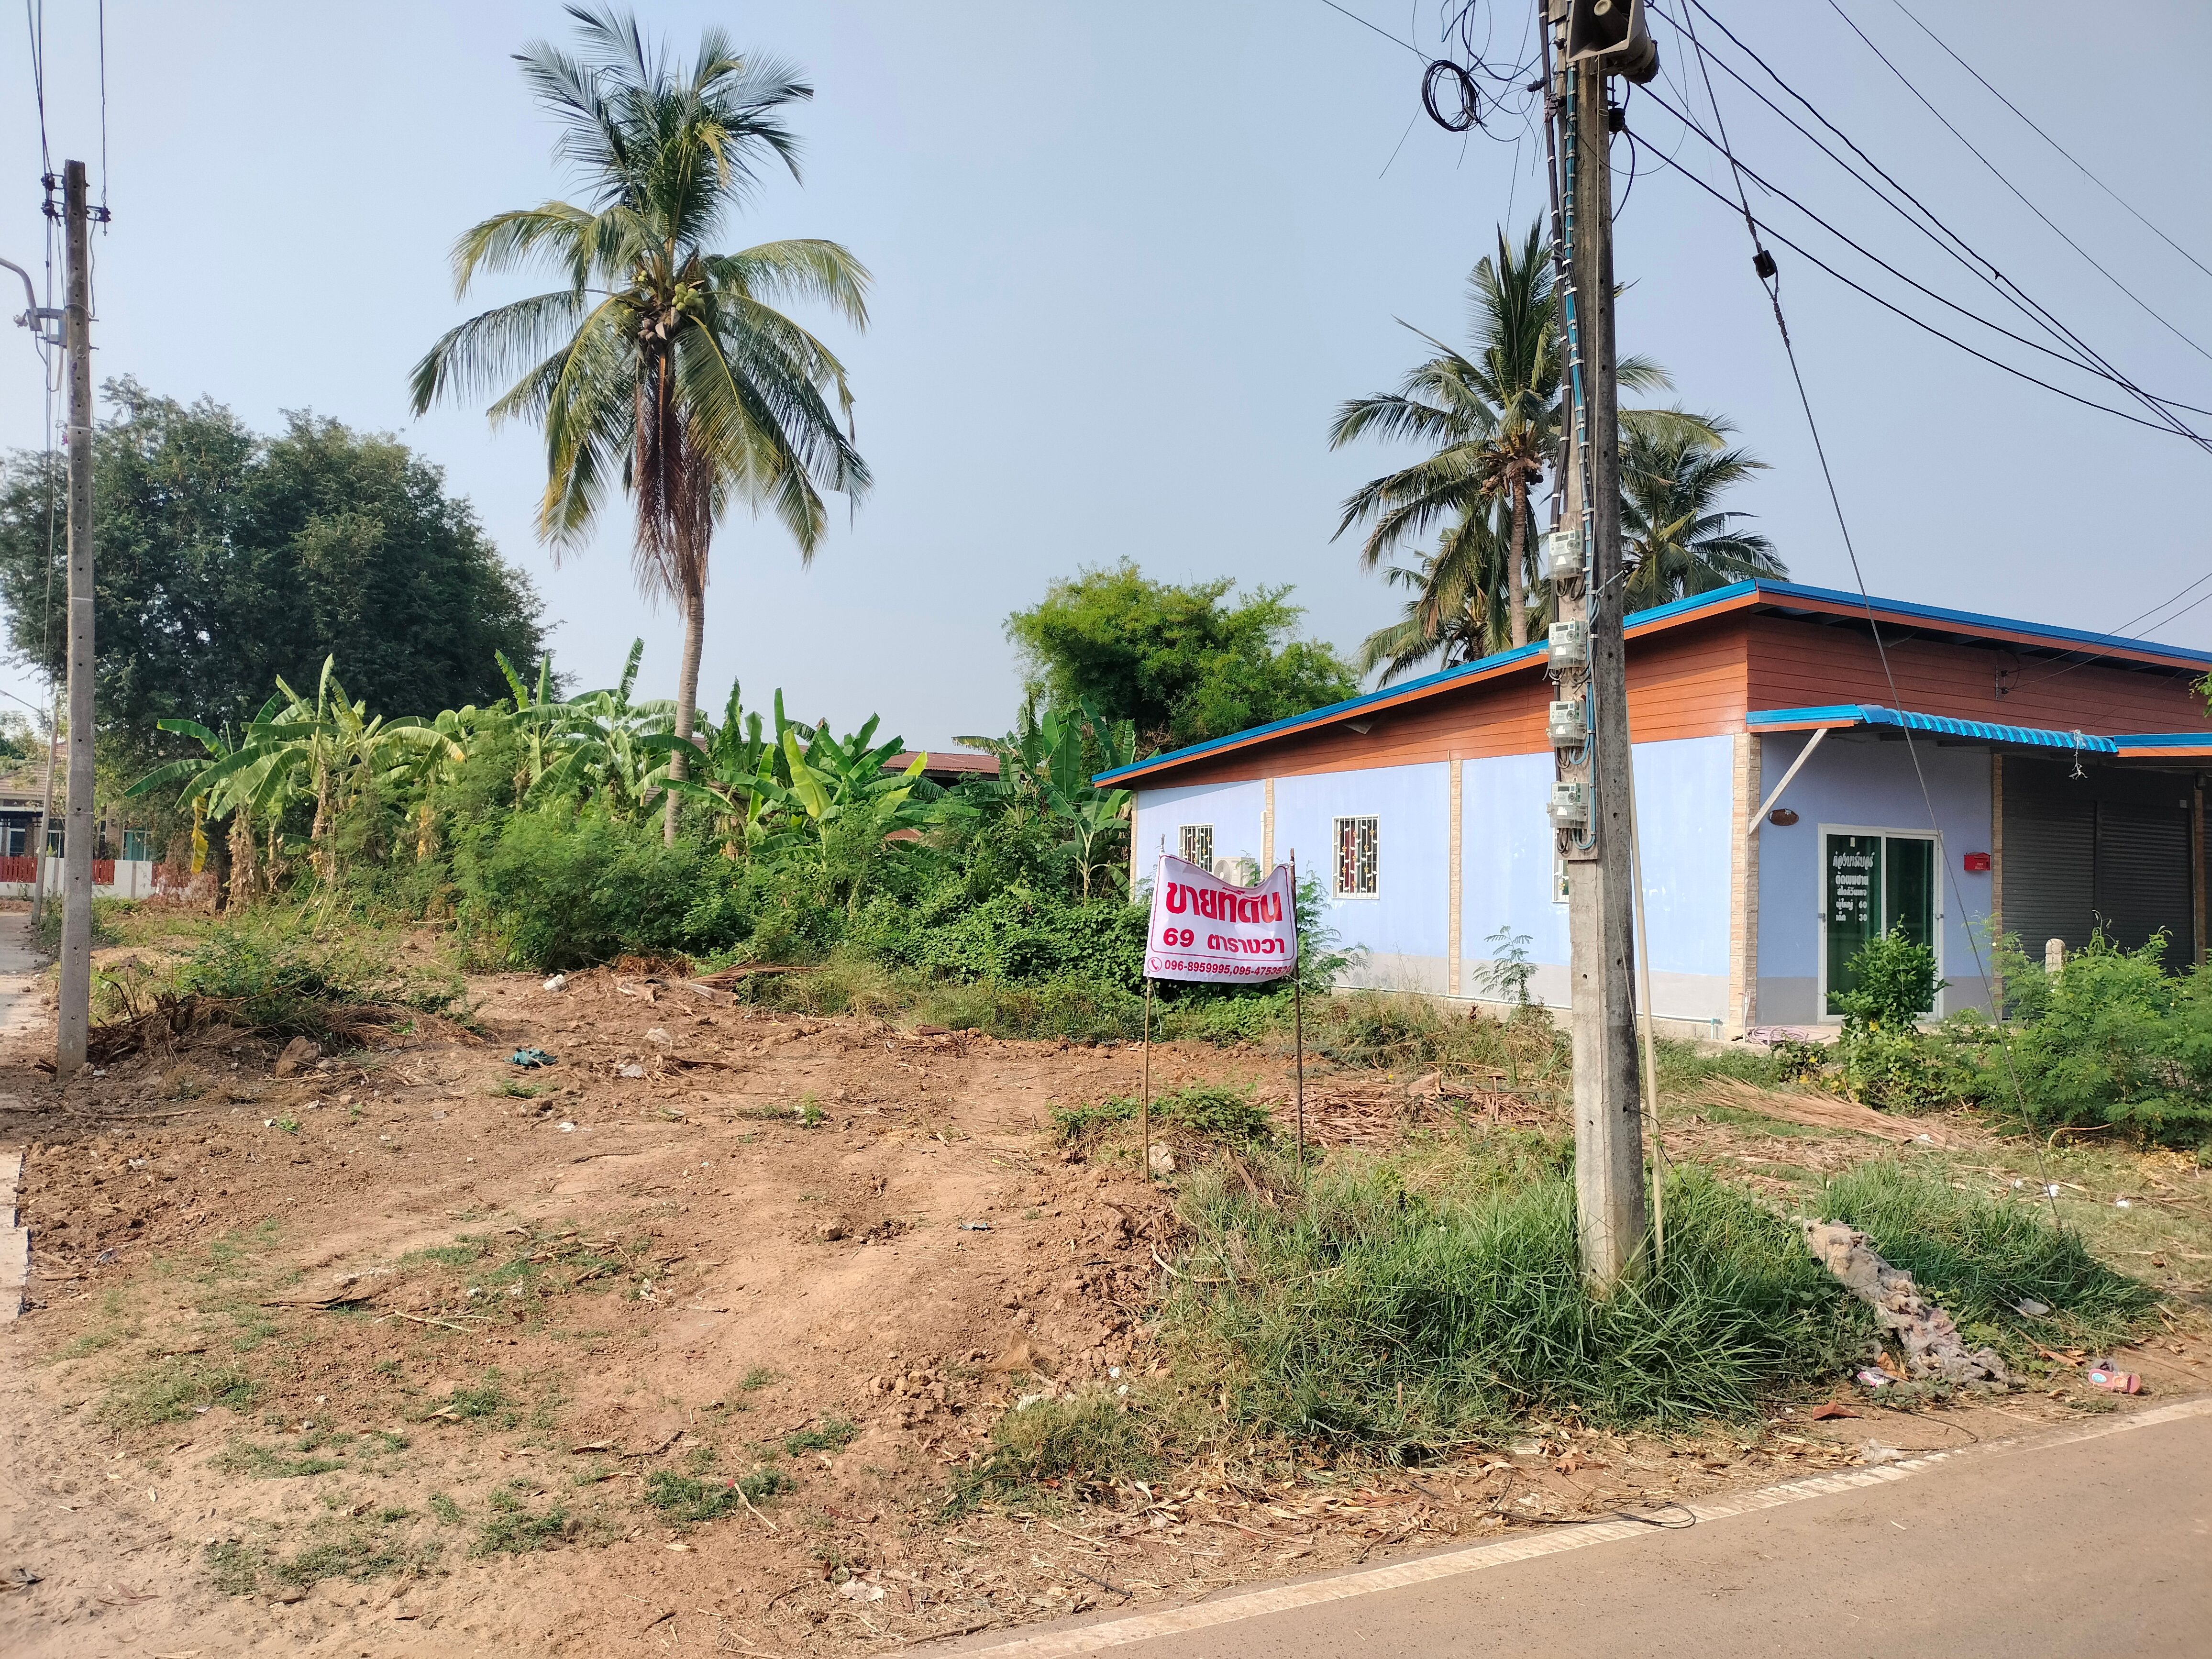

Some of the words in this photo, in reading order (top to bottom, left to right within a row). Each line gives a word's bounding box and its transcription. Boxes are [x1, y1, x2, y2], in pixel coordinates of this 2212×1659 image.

[1836, 871, 1869, 885] ตัดผมชาย
[1166, 882, 1283, 923] ขายที่ดิน
[1836, 897, 1853, 911] ผู้ใหญ่
[1858, 901, 1868, 909] 60
[1836, 911, 1846, 921] เด็ก
[1858, 913, 1868, 921] 30
[1163, 928, 1194, 948] 69
[1207, 934, 1285, 954] ตารางวา
